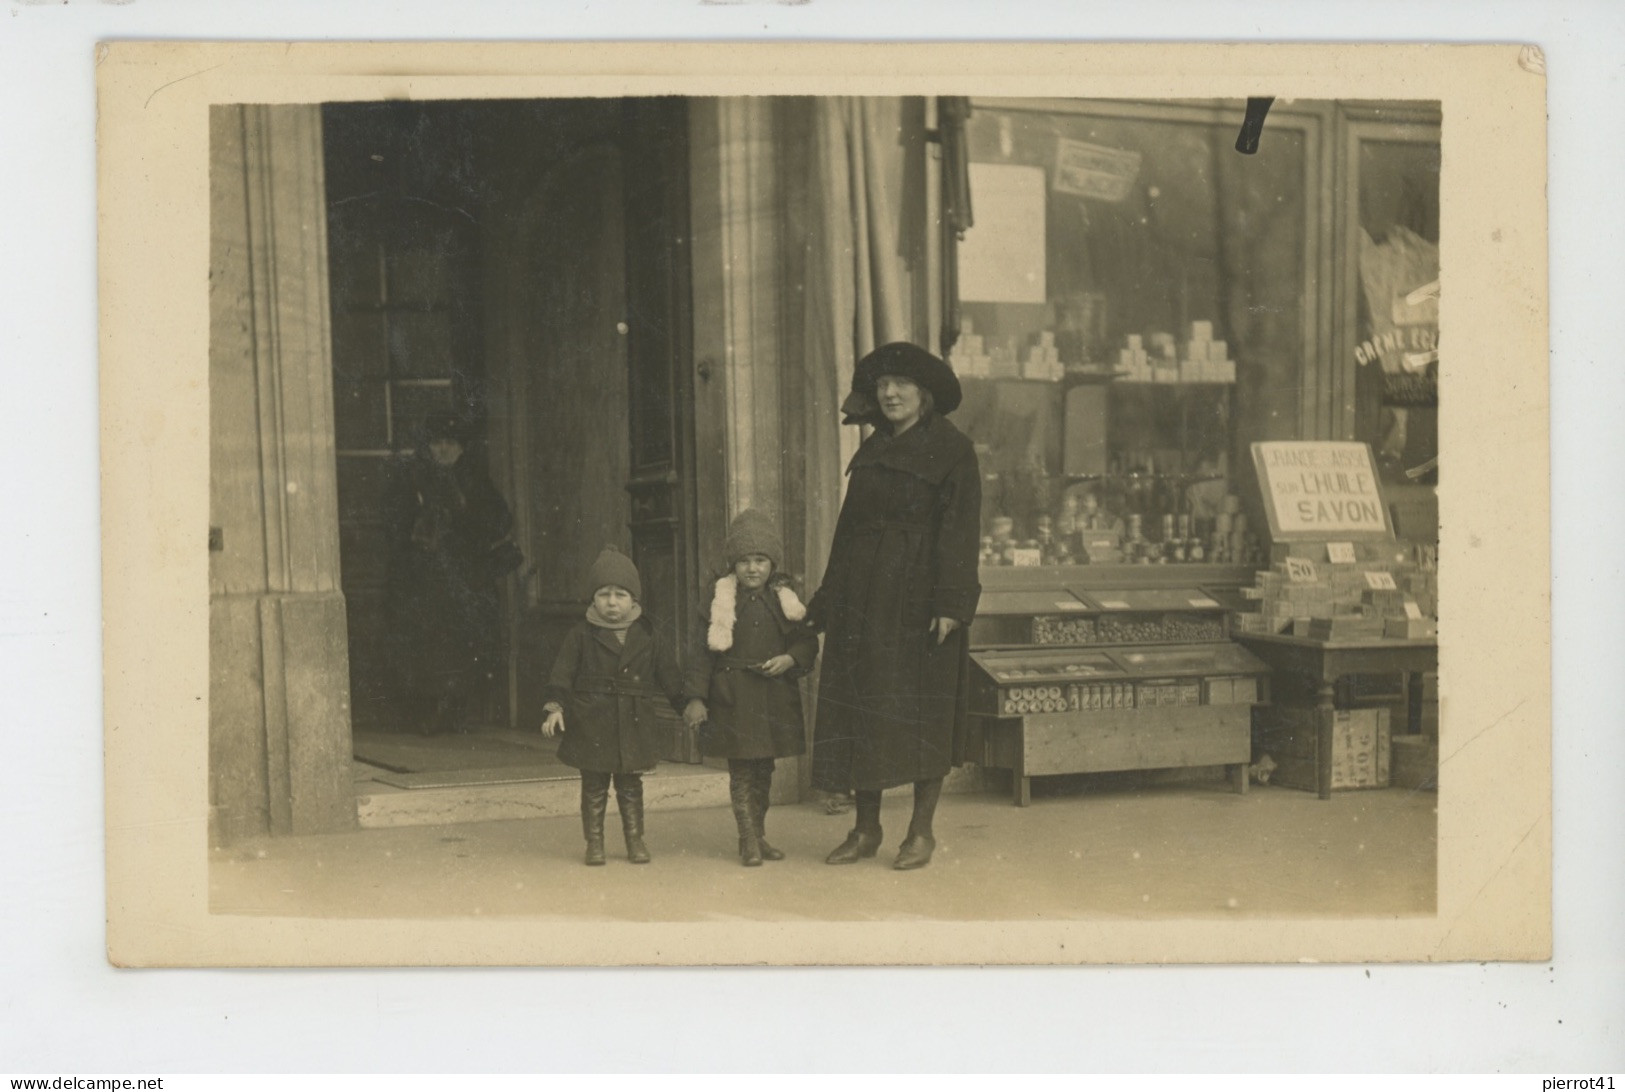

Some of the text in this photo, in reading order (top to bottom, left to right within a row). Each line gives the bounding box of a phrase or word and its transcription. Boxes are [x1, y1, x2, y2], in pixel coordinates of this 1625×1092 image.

[1321, 449, 1368, 467] AISSE
[1300, 472, 1373, 495] L'HUILE
[1297, 500, 1379, 522] SAVON
